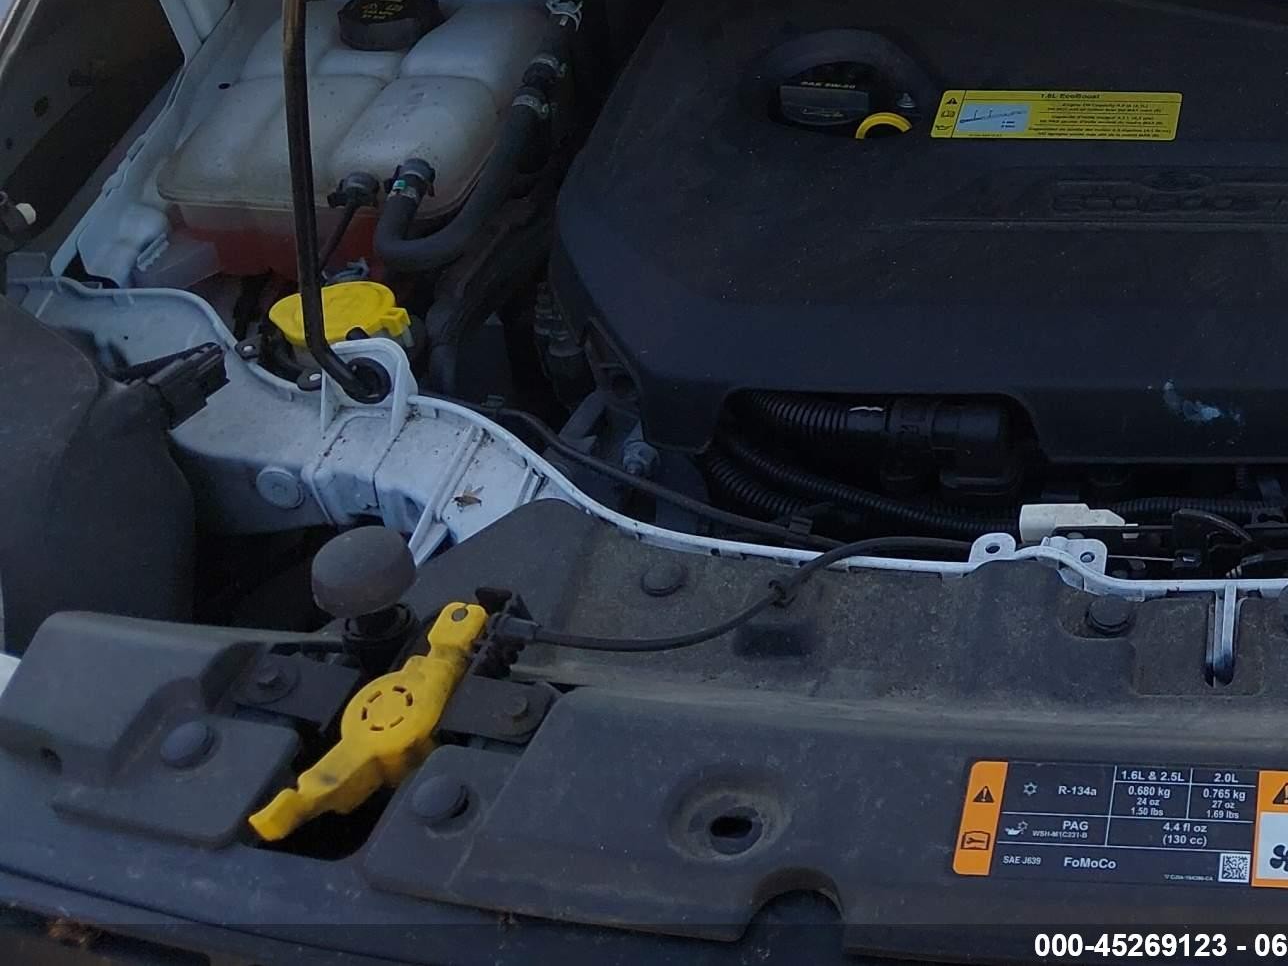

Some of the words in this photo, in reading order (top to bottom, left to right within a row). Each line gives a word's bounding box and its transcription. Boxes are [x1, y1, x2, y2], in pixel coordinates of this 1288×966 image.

[1121, 770, 1145, 781] 1.6L
[1148, 771, 1157, 781] &
[1160, 772, 1185, 782] 2.5L
[1214, 773, 1239, 783] 2.0L
[1058, 785, 1097, 796] R-134a
[1128, 785, 1155, 796] 0.680
[1158, 787, 1171, 798] kg
[1203, 788, 1231, 799] 0.765
[1233, 790, 1246, 801] kg
[1136, 797, 1148, 806] 24
[1149, 799, 1160, 807] oz
[1211, 800, 1223, 809] 27
[1224, 802, 1235, 810] oz
[1131, 807, 1148, 816] 1.50
[1150, 807, 1164, 816] lbs
[1206, 810, 1224, 819] 1.69
[1226, 810, 1239, 819] lbs
[1062, 820, 1089, 831] PAG
[1162, 822, 1180, 832] 4.4
[1183, 822, 1191, 832] fl
[1193, 824, 1208, 833] oz
[1162, 834, 1187, 846] (130
[1189, 835, 1207, 846] cc)
[1003, 855, 1021, 864] SAE
[1022, 856, 1042, 865] J639
[1063, 856, 1117, 870] FoMoCo
